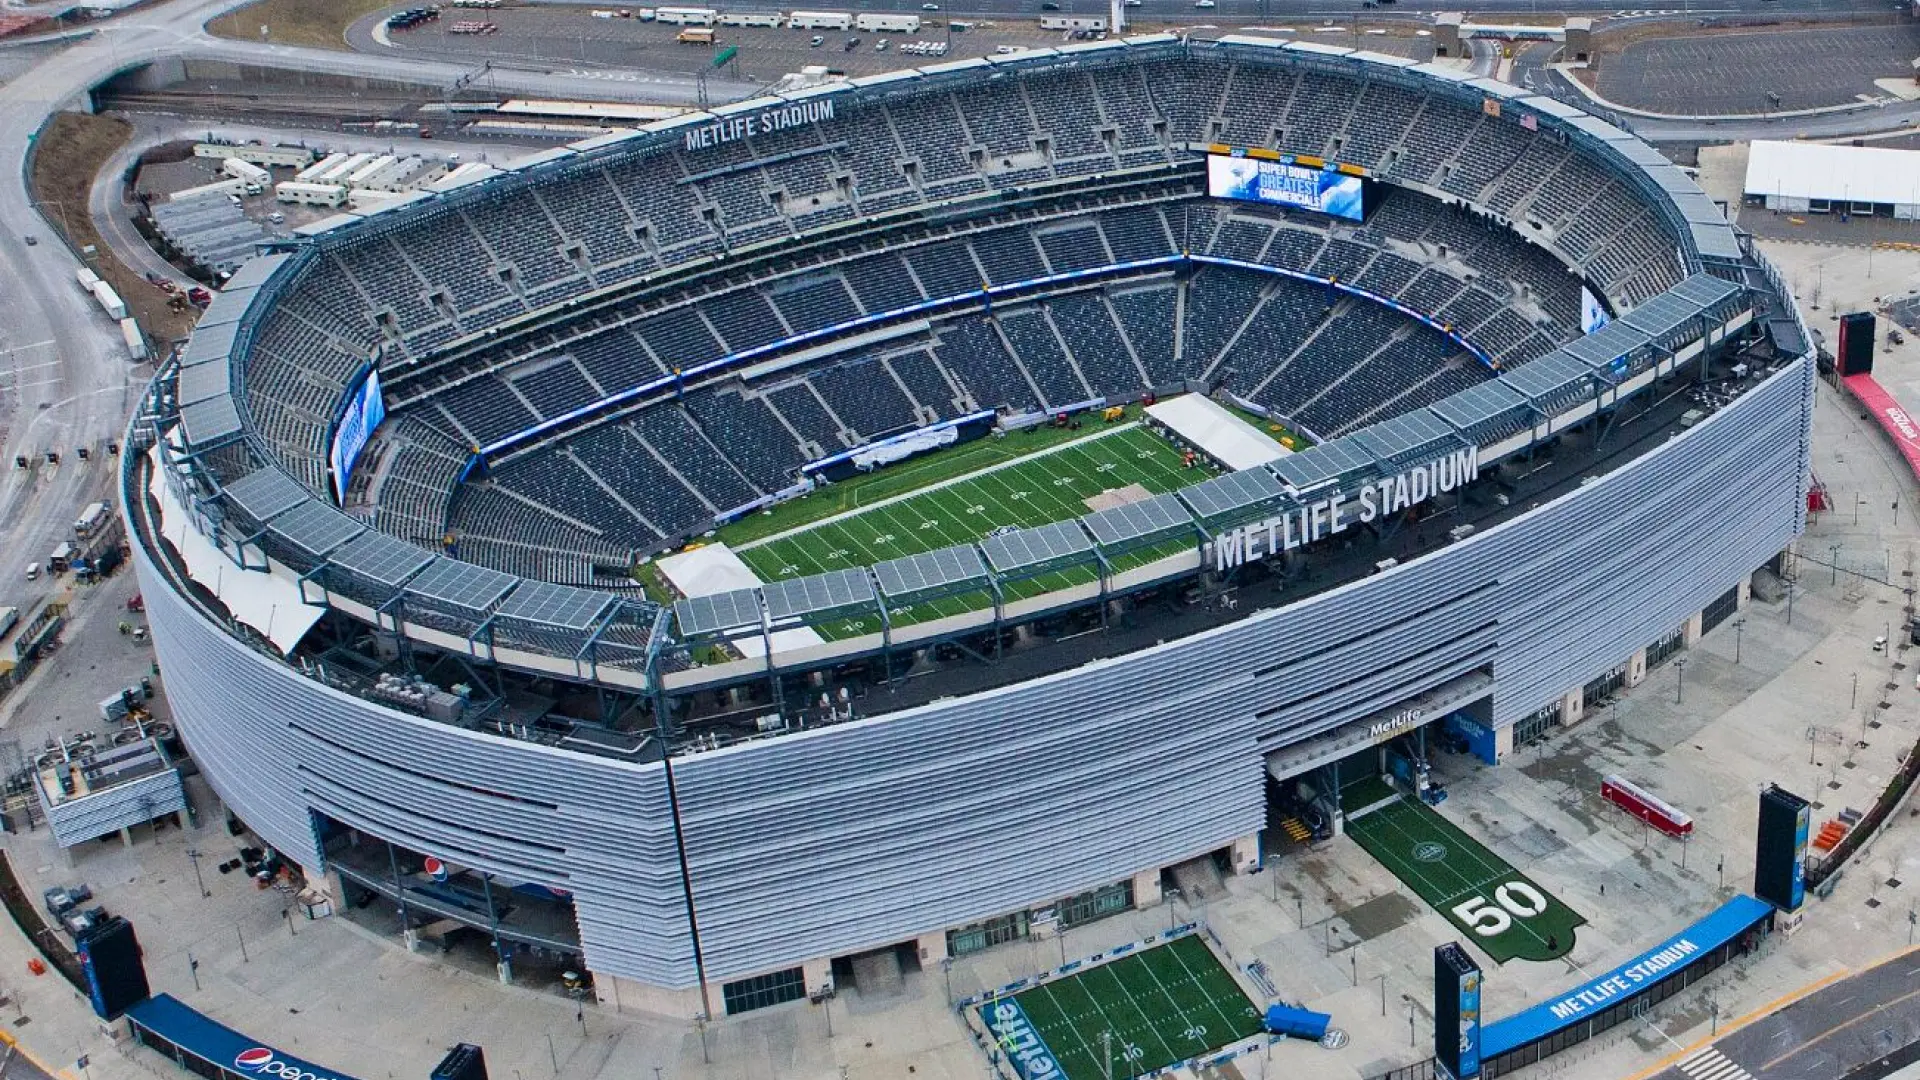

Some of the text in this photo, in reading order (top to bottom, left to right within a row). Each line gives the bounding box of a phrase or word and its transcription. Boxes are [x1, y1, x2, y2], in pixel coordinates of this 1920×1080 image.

[686, 99, 834, 150] METLIFE STADIUM
[1258, 162, 1320, 182] SUPER BOWL'S
[1259, 187, 1321, 207] COMMERCIALS
[1260, 174, 1320, 196] GREATEST
[1217, 447, 1478, 572] METLIFE STADIUM
[1370, 709, 1421, 738] MetLife
[1452, 881, 1547, 937] 50
[1550, 939, 1700, 1020] METLIFE STADIUM
[991, 1003, 1062, 1080] etLife
